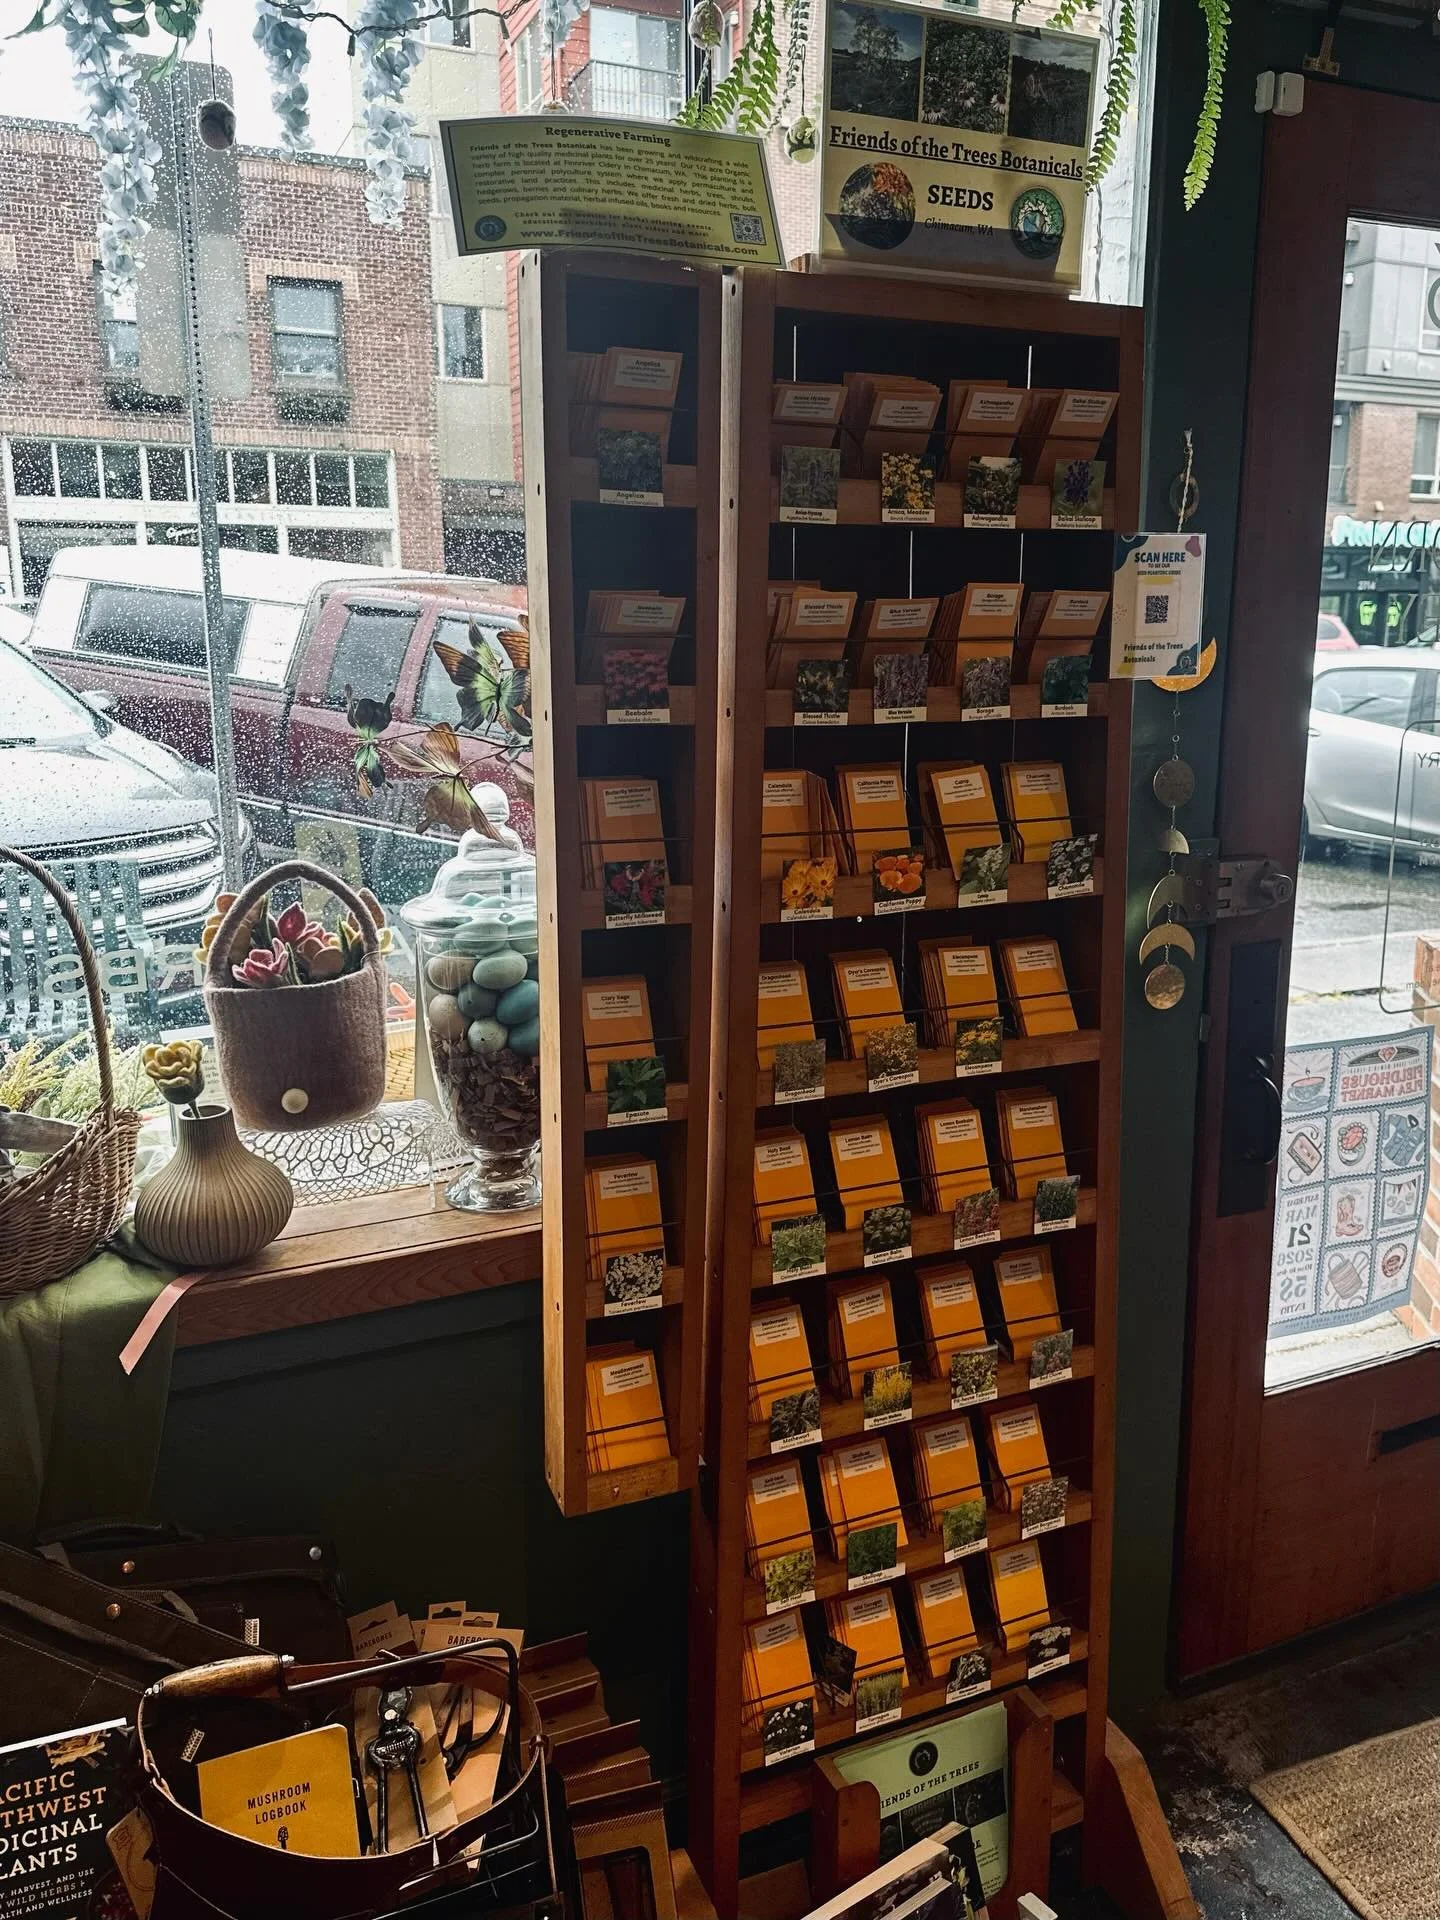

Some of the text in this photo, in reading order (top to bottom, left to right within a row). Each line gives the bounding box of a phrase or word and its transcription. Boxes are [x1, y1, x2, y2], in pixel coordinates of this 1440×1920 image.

[545, 127, 671, 147] Regenerative Farming
[470, 143, 499, 152] Friends
[600, 143, 613, 151] has
[616, 146, 634, 154] been
[637, 149, 665, 160] growing
[668, 151, 681, 159] and
[684, 153, 722, 167] wildcrafting
[830, 125, 1083, 178] Friends of the Trees Botanicals
[498, 151, 506, 159] of
[508, 151, 524, 160] high
[527, 150, 552, 160] quality
[554, 151, 589, 159] medicinal
[591, 152, 613, 161] plants
[725, 168, 750, 179] Organic
[523, 159, 550, 167] located
[927, 184, 994, 211] SEEDS
[924, 217, 993, 236] Chimacum, WA
[635, 359, 661, 368] Angelica
[616, 491, 645, 500] Angelica
[971, 515, 1008, 523] Ashwagandha
[1134, 551, 1186, 563] SCAN HERE
[1124, 643, 1147, 652] Friends
[1124, 655, 1156, 664] Botanicals
[625, 709, 653, 717] Beebalm
[976, 707, 995, 715] Borage
[878, 897, 922, 909] California Poppy
[794, 907, 821, 915] Calendula
[608, 911, 663, 923] Butterfly Milkweed
[601, 995, 616, 1003] Clary
[965, 1063, 993, 1071] Elecampane
[873, 1073, 914, 1086] Dyer's Coreopsis
[784, 1088, 816, 1097] Dragonhead
[625, 1110, 650, 1119] Epazote
[613, 1171, 638, 1180] Feverfew
[1041, 1219, 1069, 1228] Marshmallow
[959, 1235, 974, 1243] Lemon
[873, 1251, 891, 1259] Lemon
[621, 1298, 646, 1308] Feverfew
[355, 1632, 394, 1652] BAREBONES
[880, 1761, 980, 1810] IENDS OF THE TREES
[247, 1782, 312, 1811] MUSHROOM
[254, 1799, 308, 1825] LOGBOOK
[56, 1873, 75, 1885] AND
[78, 1867, 96, 1878] USE
[6, 1893, 36, 1909] WILD
[40, 1882, 76, 1899] HERBS
[25, 1902, 45, 1914] AND
[47, 1888, 93, 1907] WELLNESS
